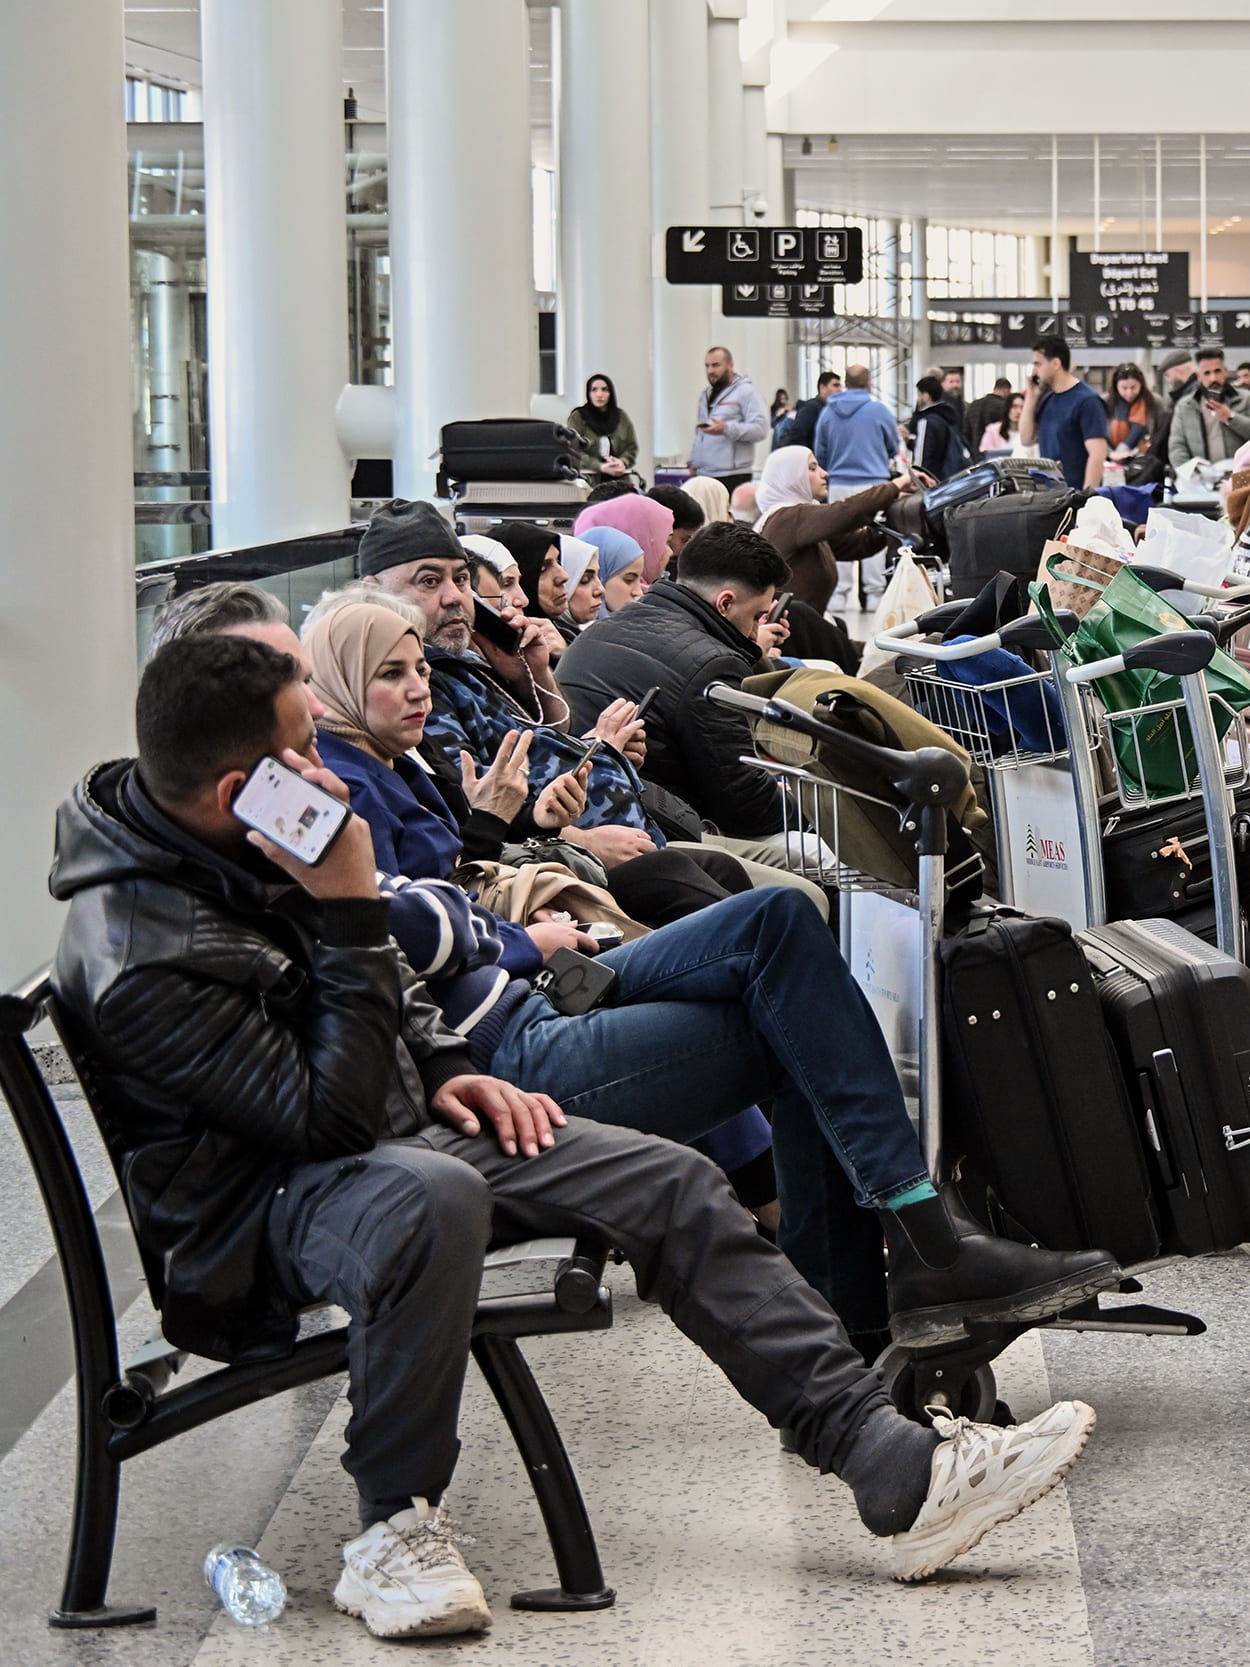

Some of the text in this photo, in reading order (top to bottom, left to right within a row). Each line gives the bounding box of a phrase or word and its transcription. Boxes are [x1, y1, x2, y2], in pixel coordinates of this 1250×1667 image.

[778, 234, 797, 257] P
[1090, 253, 1169, 266] Departure East
[1108, 297, 1117, 311] 1
[1040, 839, 1066, 862] MEAS
